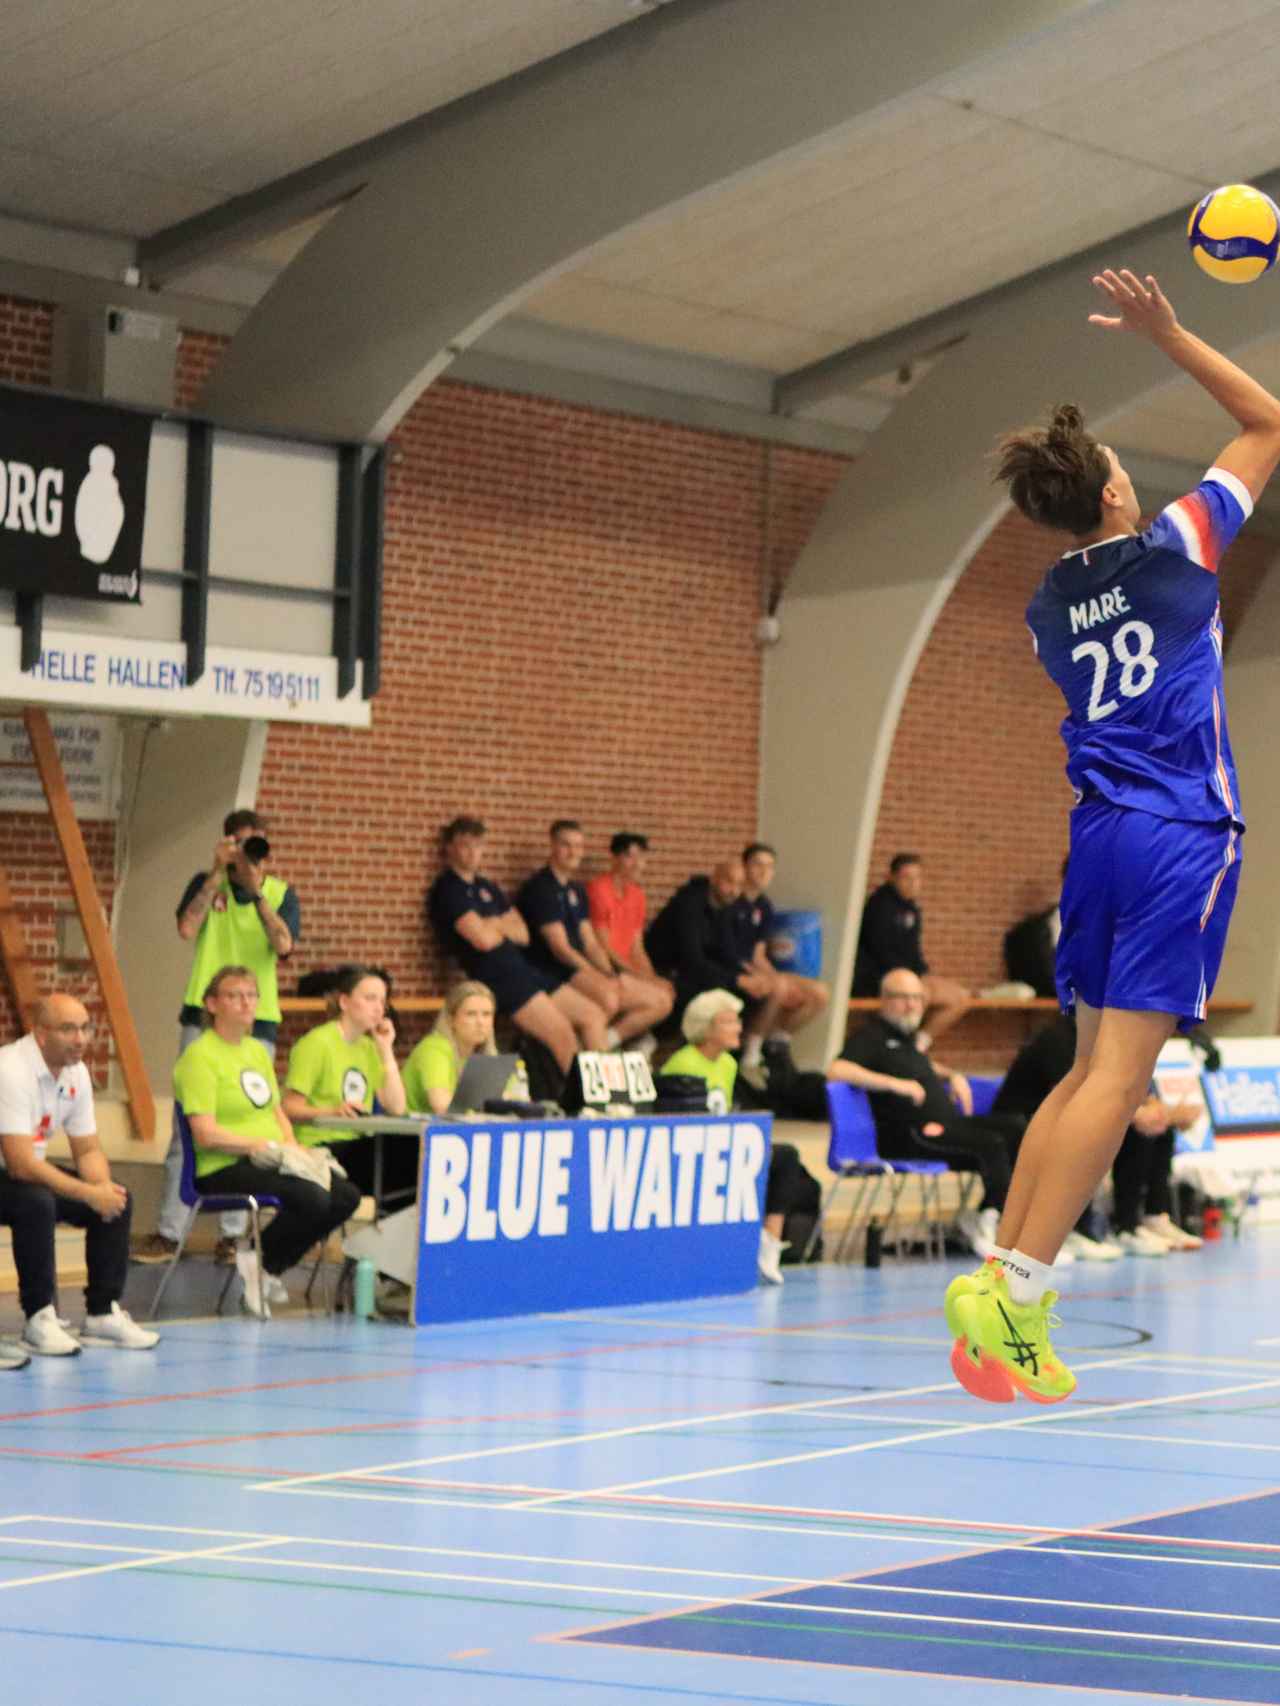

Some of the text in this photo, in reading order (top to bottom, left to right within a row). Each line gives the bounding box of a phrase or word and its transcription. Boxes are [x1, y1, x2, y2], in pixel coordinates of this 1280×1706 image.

[0, 458, 64, 538] RG
[1069, 585, 1132, 634] MARE
[107, 656, 188, 689] HALLEN
[1071, 620, 1160, 722] 28
[424, 1122, 766, 1244] BLUE WATER
